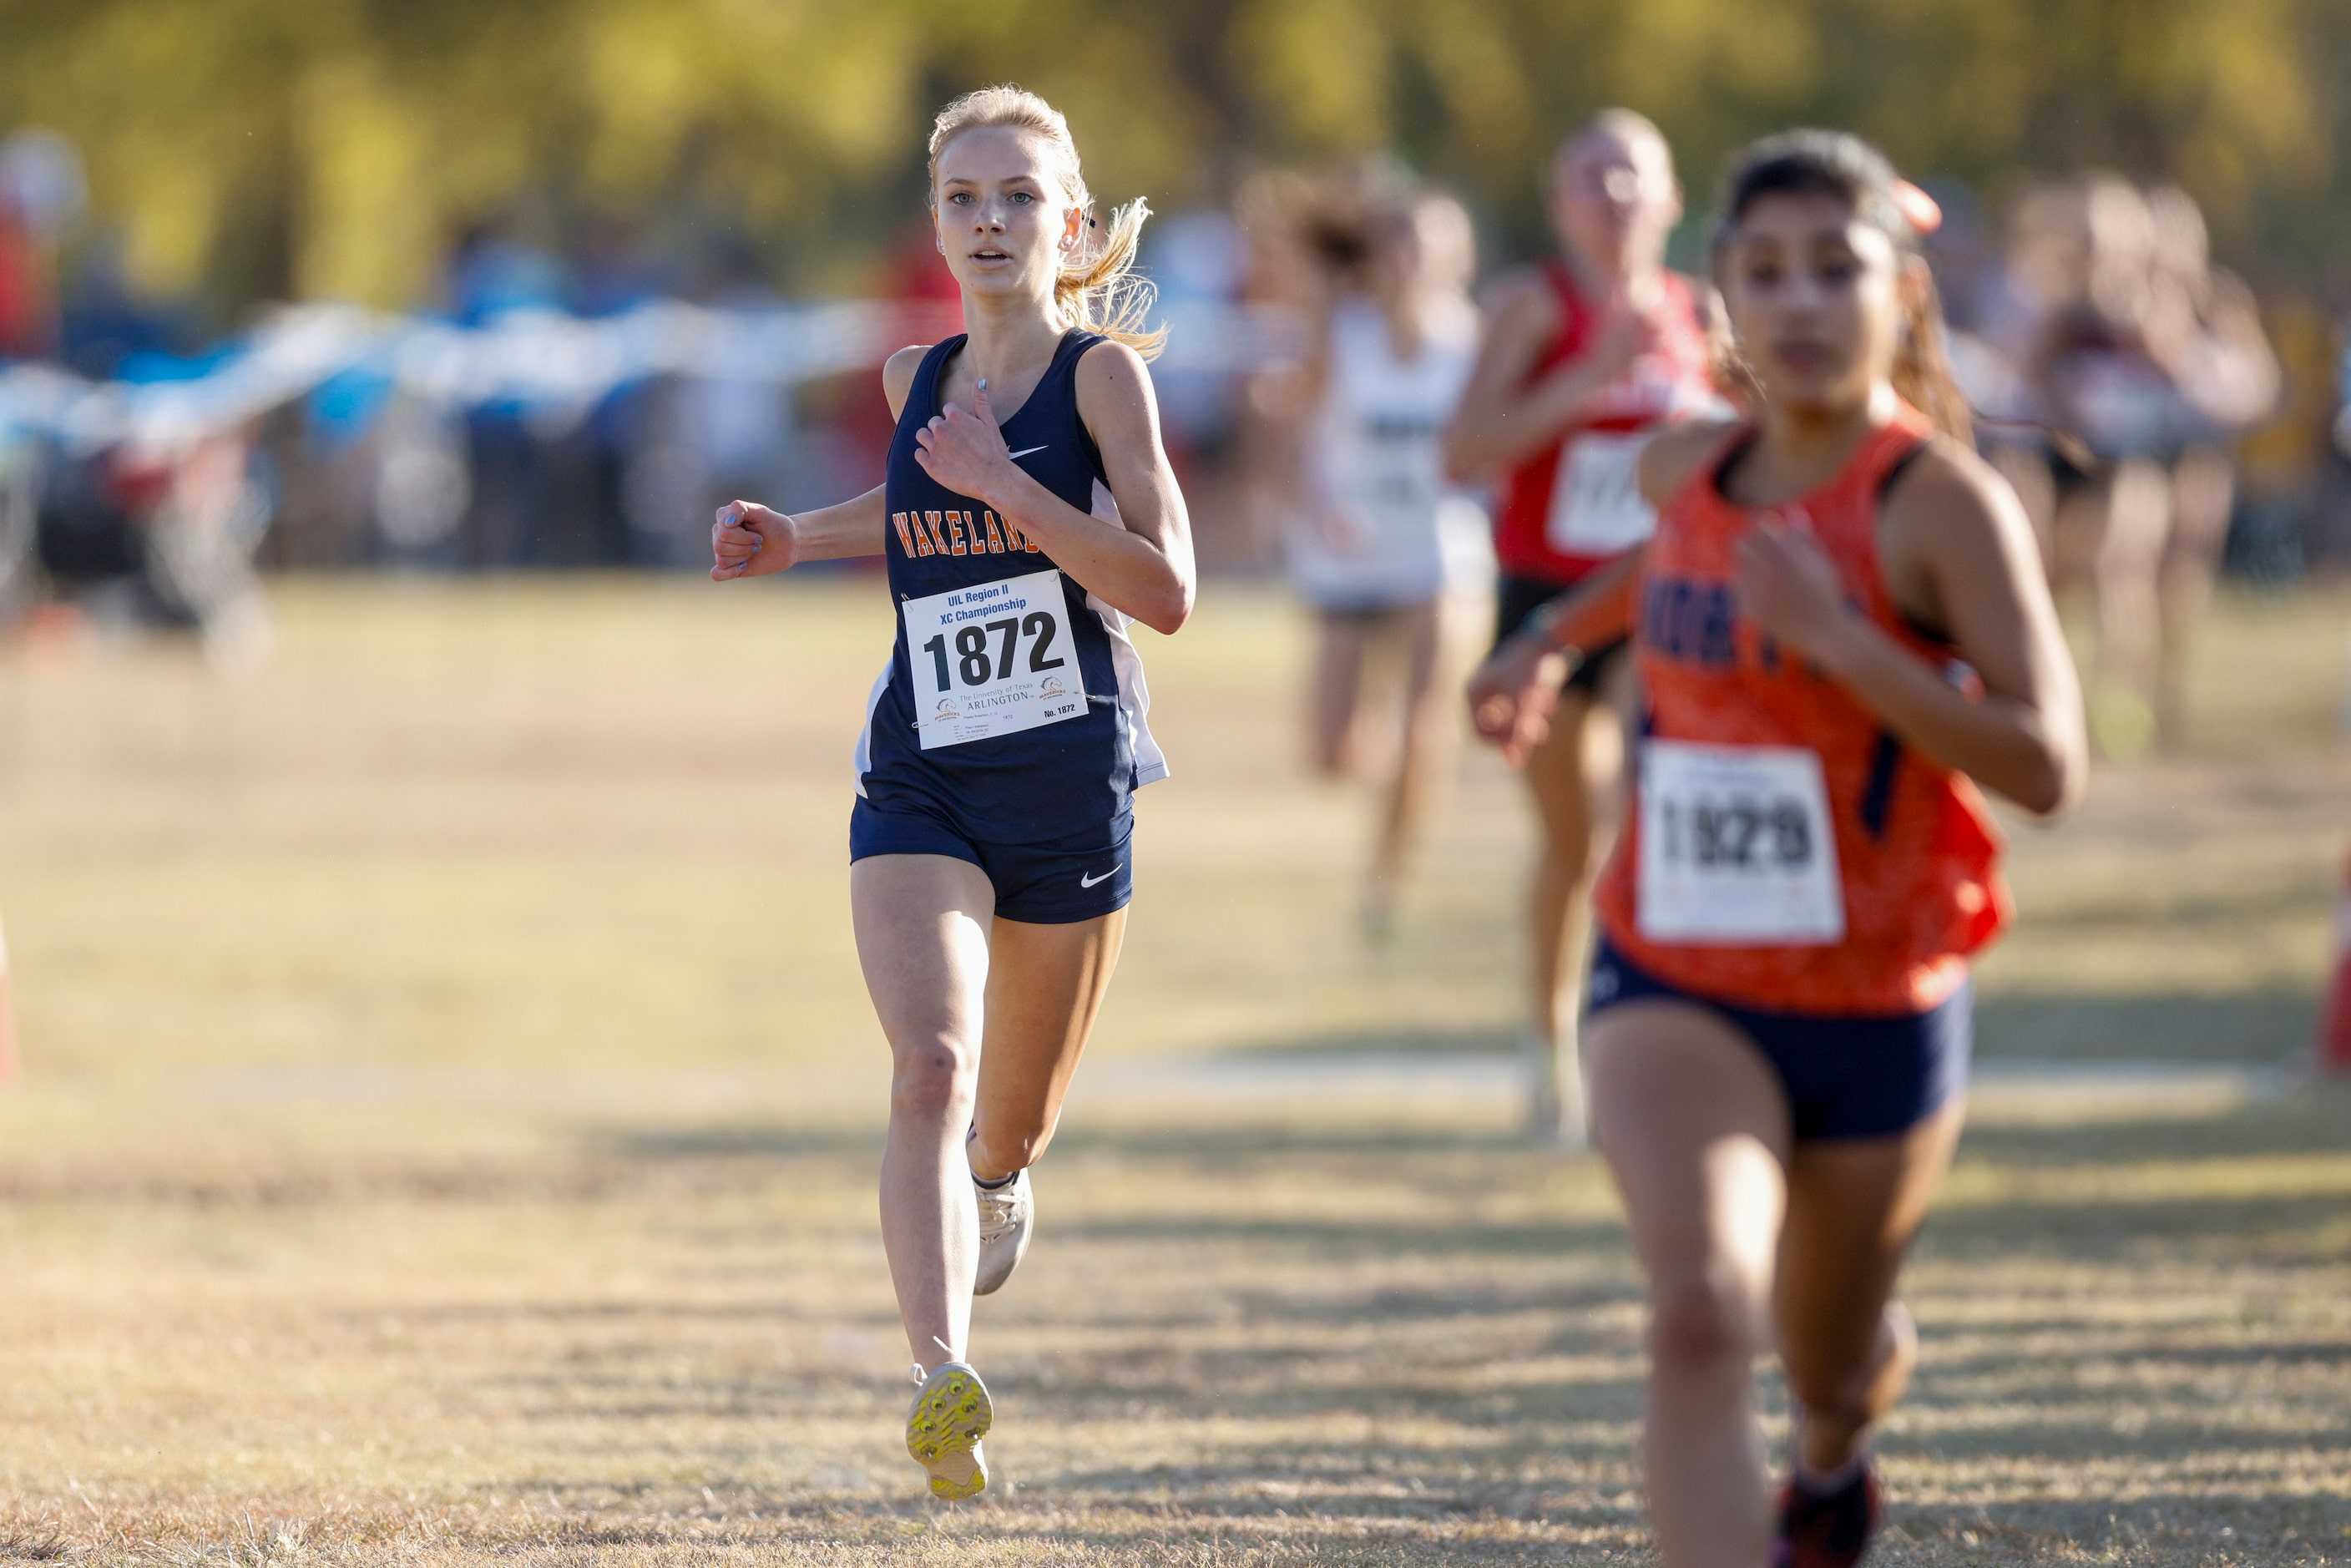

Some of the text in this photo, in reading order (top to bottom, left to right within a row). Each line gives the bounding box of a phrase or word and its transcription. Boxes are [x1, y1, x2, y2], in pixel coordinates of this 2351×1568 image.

[948, 584, 1009, 607] UIL Region II
[940, 598, 1027, 625] XC Championship
[923, 611, 1064, 692] 1872
[967, 691, 1029, 711] ARLINGTON
[973, 689, 1004, 700] University
[1015, 683, 1034, 691] Texas
[1044, 703, 1075, 719] No. 1872
